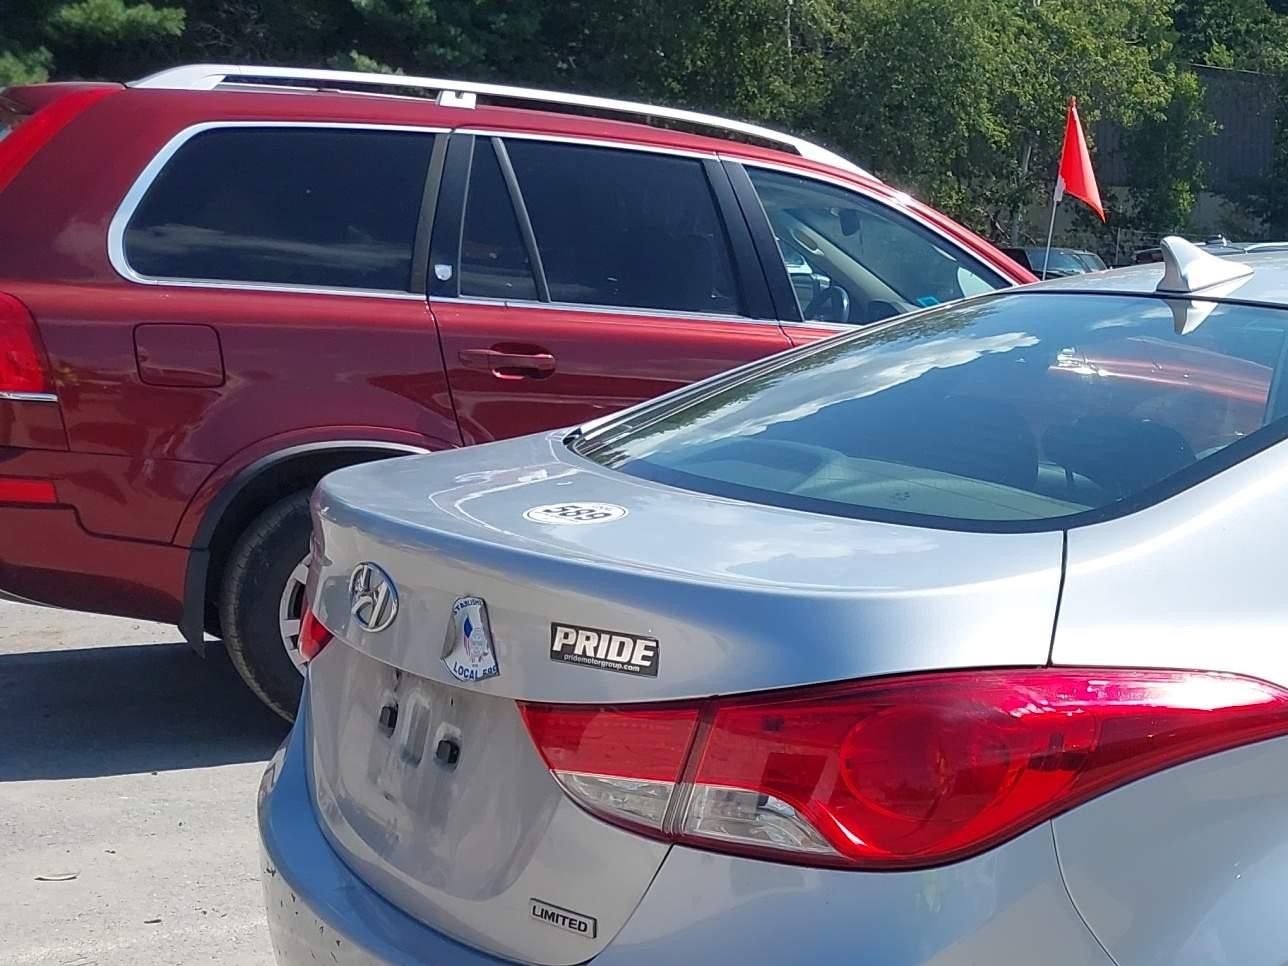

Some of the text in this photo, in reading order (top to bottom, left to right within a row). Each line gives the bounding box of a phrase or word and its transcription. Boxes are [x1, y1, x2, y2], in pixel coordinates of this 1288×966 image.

[552, 626, 656, 666] PRIDE
[453, 662, 479, 680] LOCAL
[564, 653, 640, 672] pridemotorgroup.com
[532, 905, 588, 933] LIMITED
